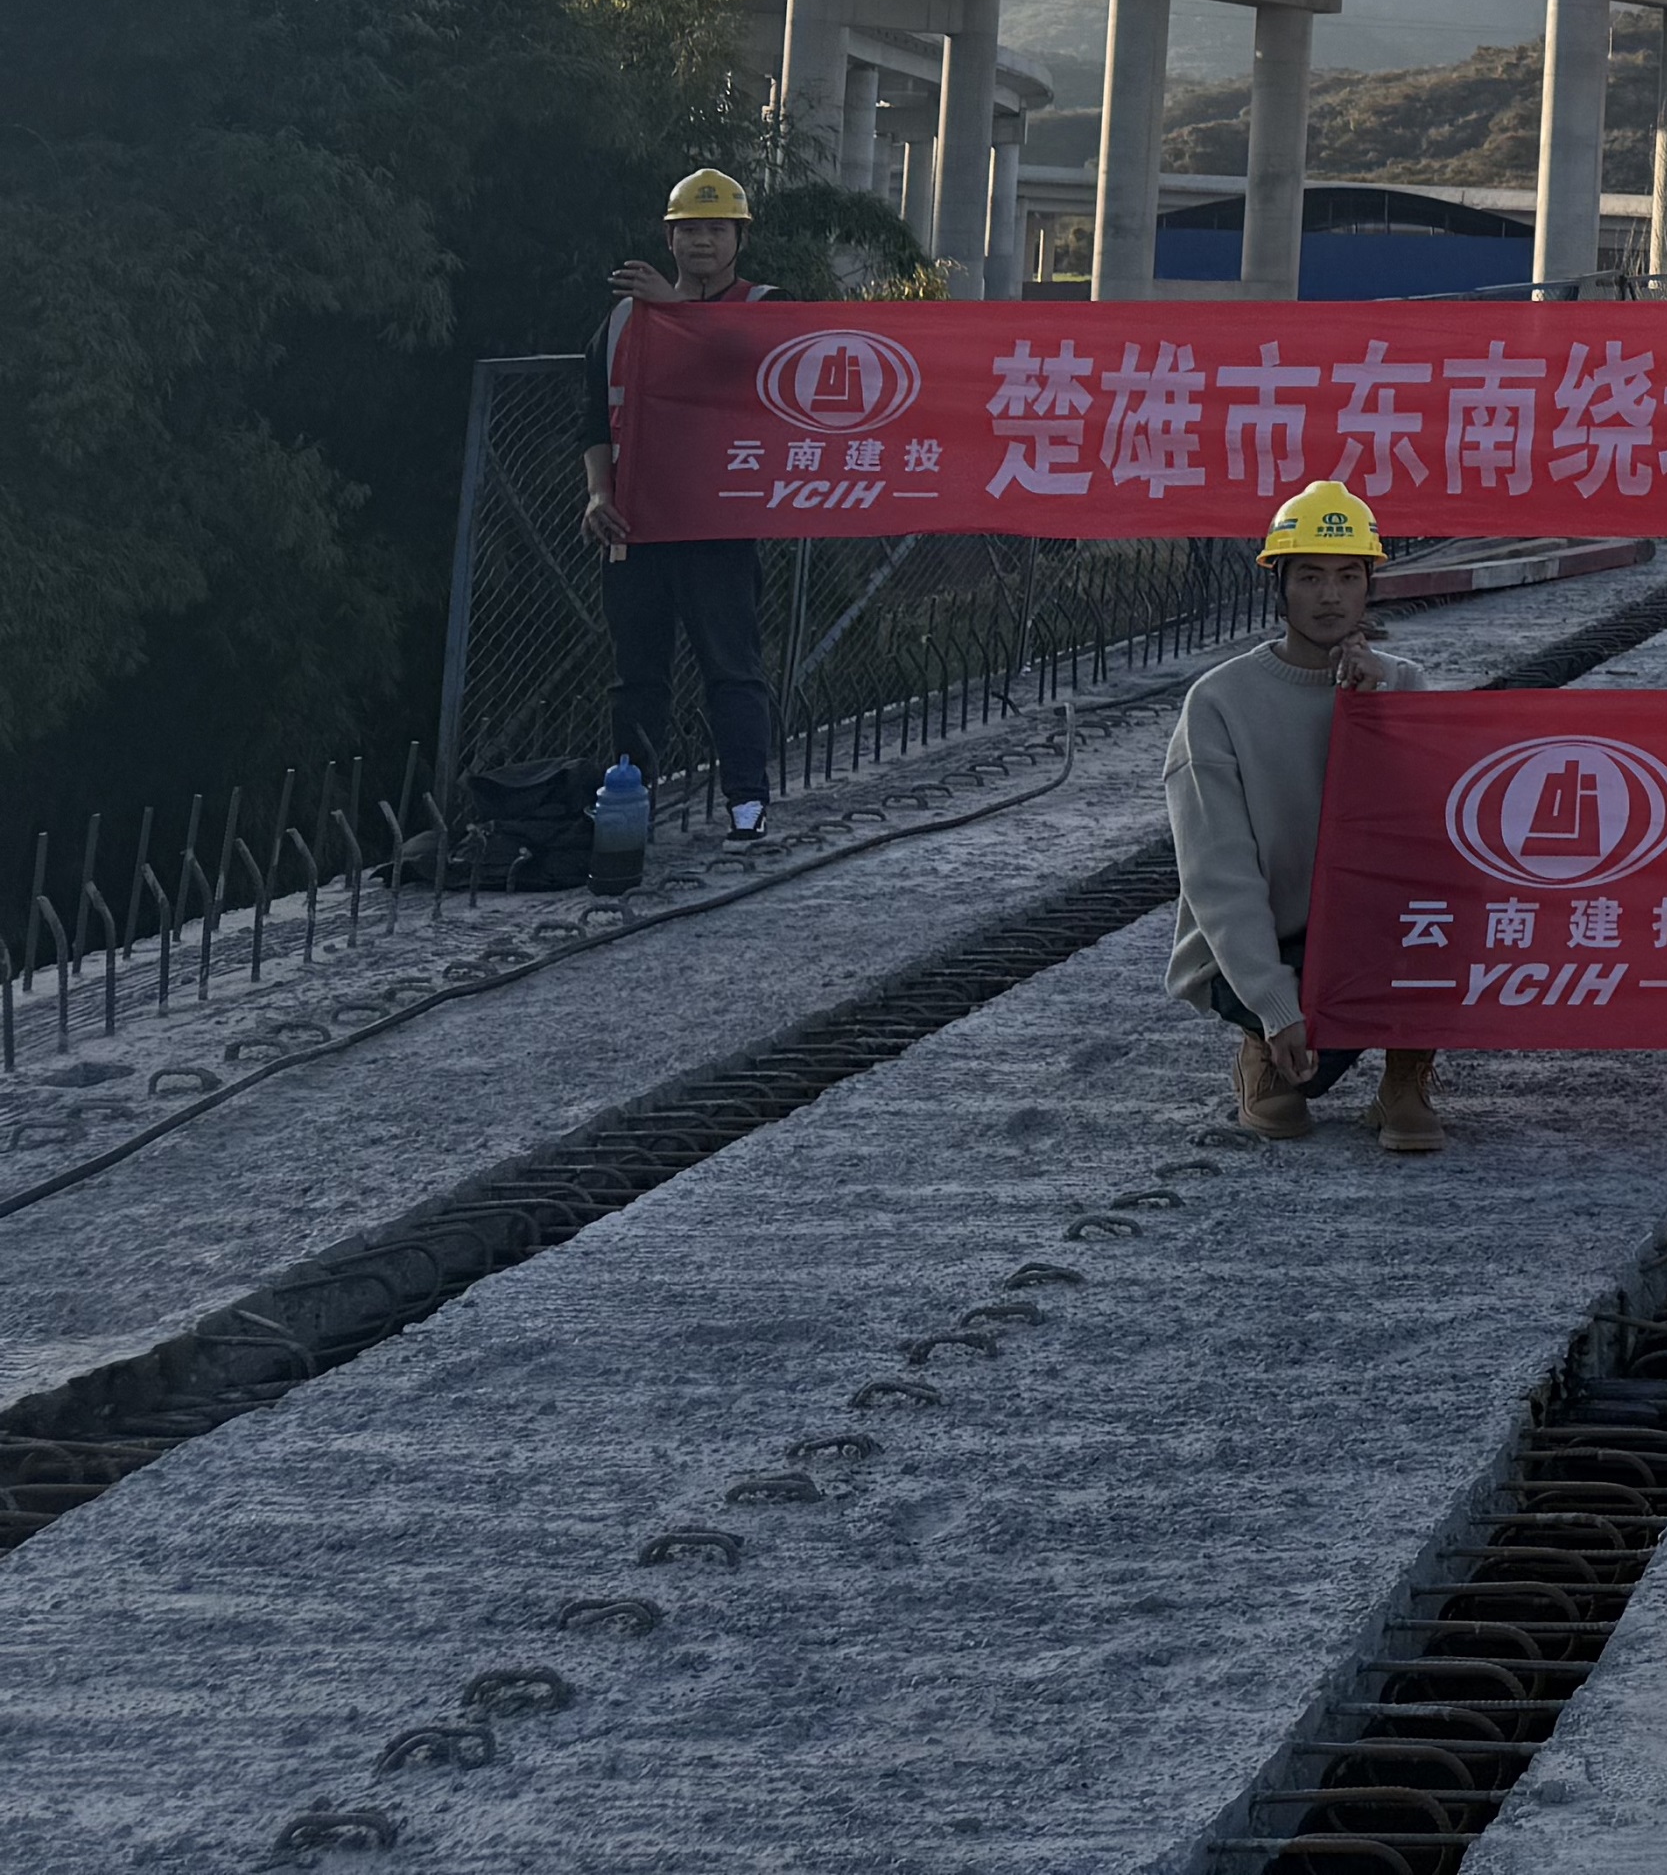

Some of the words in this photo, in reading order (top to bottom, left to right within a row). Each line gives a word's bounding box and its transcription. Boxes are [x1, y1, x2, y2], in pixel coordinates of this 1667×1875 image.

[727, 438, 943, 473] 云南建投
[766, 480, 886, 509] YCIH
[1461, 963, 1629, 1006] YCIH
